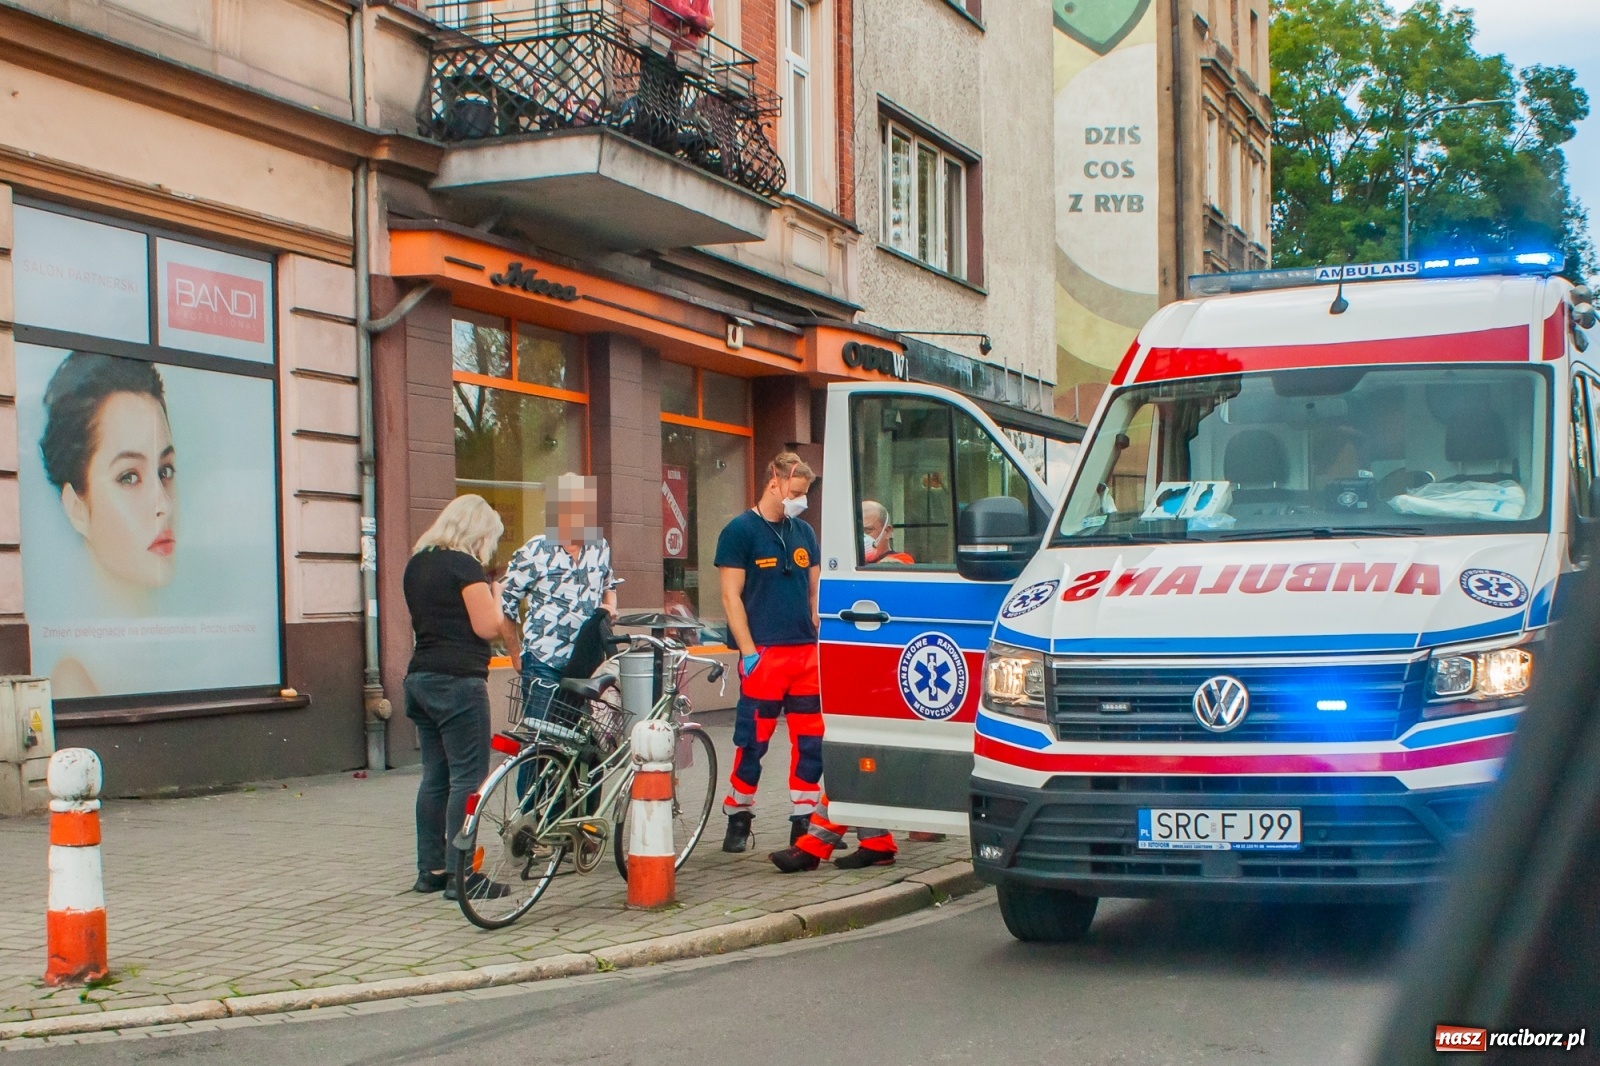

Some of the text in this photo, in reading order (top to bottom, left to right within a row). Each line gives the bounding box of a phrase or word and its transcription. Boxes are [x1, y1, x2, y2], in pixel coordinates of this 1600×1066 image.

[1085, 125, 1142, 145] DZIŚ
[1084, 159, 1135, 179] COŚ
[1068, 194, 1144, 213] Z RYB
[23, 260, 138, 293] SALON PARTNERSKI
[1318, 262, 1417, 280] AMBULANS
[176, 278, 257, 320] BANDI
[936, 638, 964, 695] RATOWNICTWO
[913, 702, 956, 716] MEDYCZNE
[1157, 812, 1210, 840] SRC
[1221, 812, 1292, 840] FJ99
